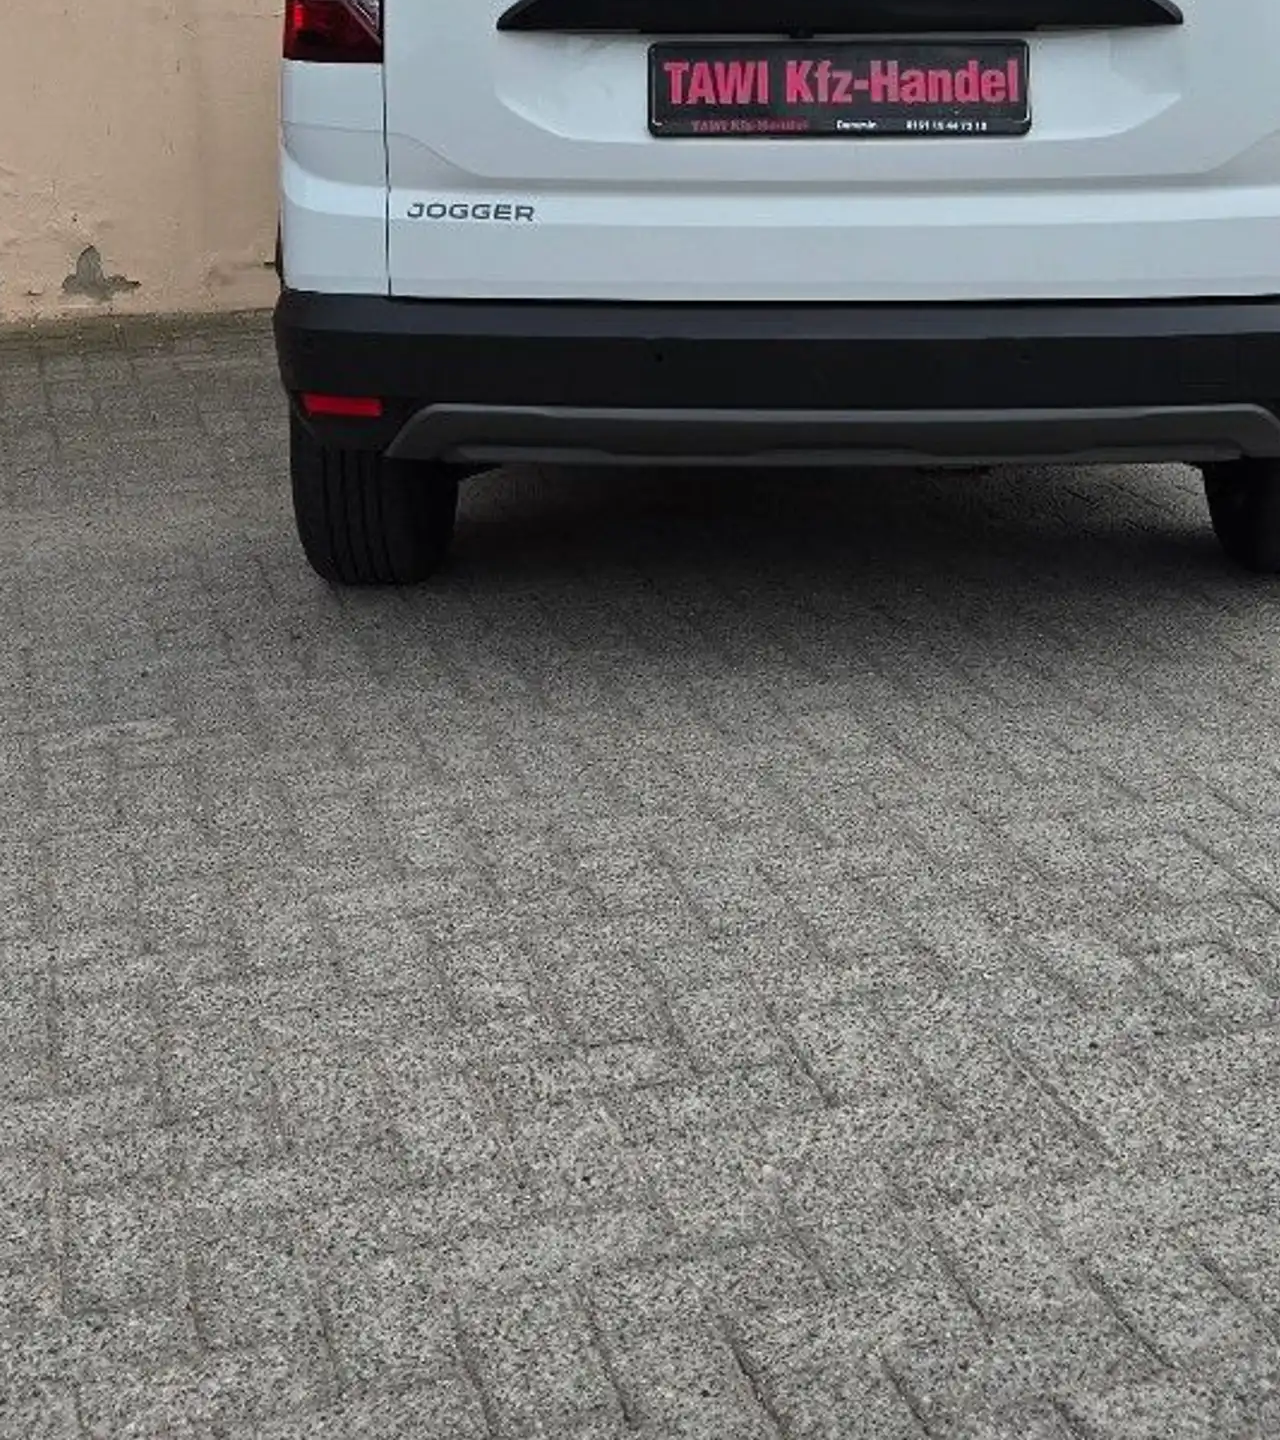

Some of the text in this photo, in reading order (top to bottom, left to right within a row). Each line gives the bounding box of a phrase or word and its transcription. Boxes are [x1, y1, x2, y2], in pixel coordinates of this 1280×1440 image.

[664, 58, 1019, 105] TAWI Kfz-Handel
[406, 203, 535, 222] JOGGER
